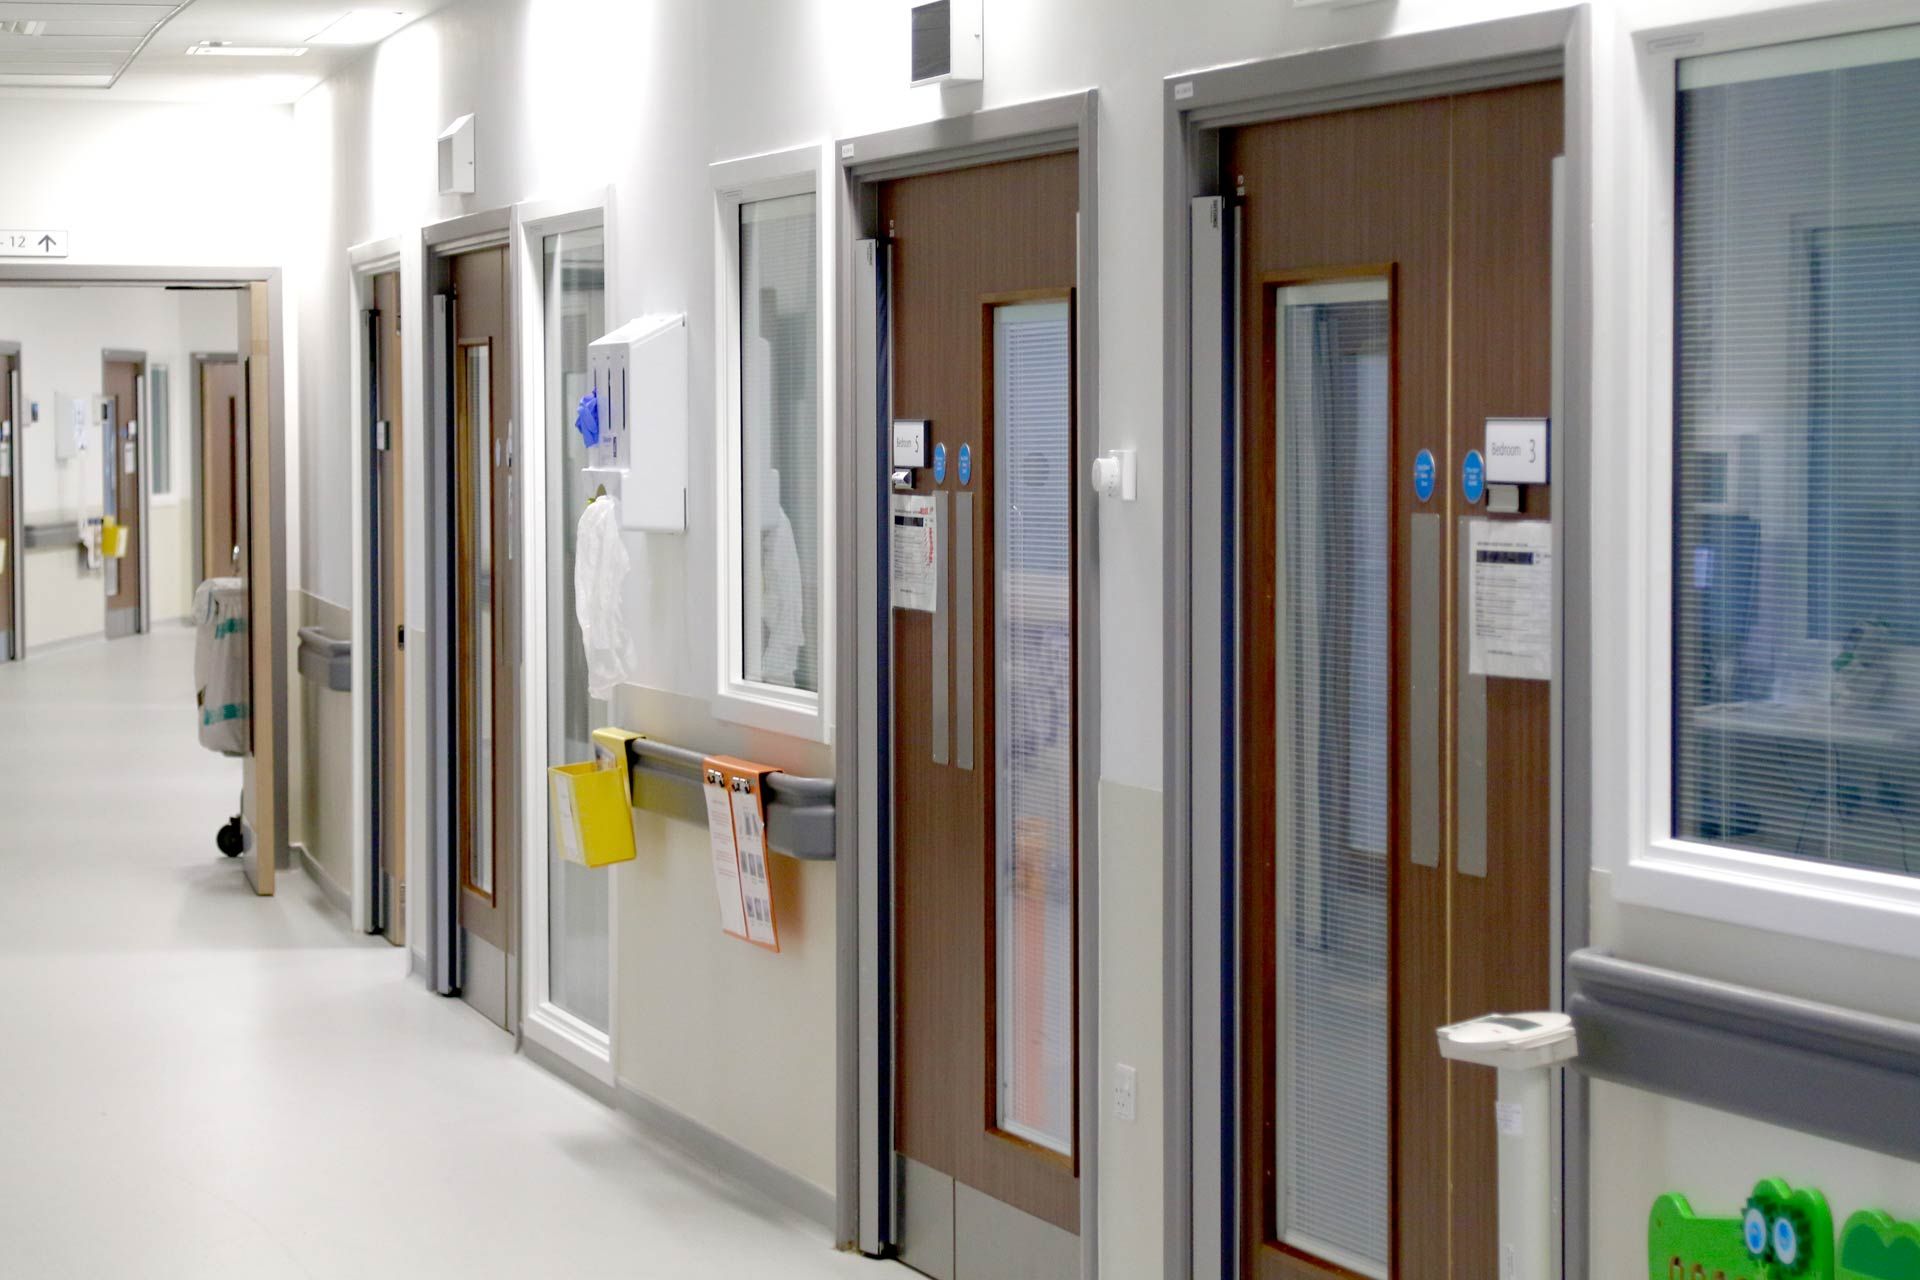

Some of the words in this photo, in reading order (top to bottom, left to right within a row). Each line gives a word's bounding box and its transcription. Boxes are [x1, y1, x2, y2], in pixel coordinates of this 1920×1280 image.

[10, 236, 26, 248] 12
[914, 434, 920, 453] 5
[1491, 442, 1522, 456] Bedroom
[1528, 439, 1536, 463] 3
